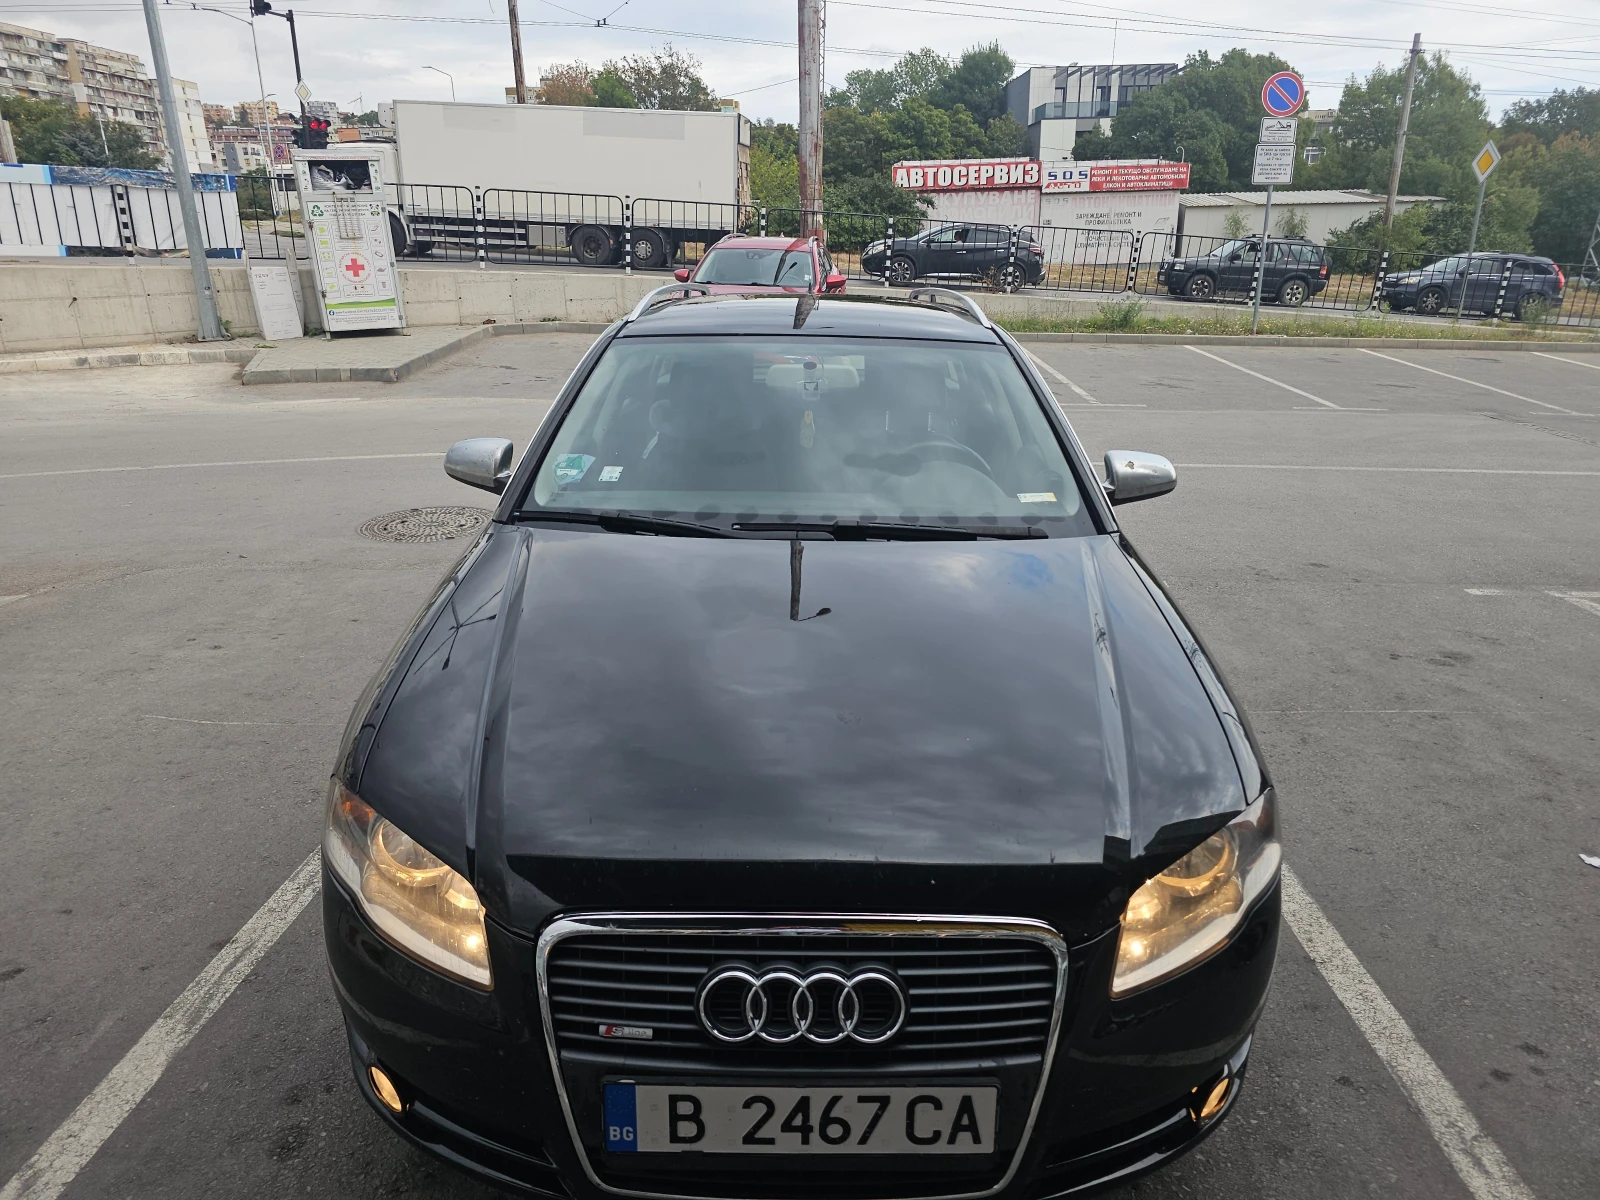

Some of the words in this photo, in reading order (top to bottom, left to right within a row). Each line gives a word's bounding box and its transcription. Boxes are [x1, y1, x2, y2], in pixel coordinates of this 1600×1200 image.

[895, 163, 1040, 188] АВТОСЕРВИЗ
[667, 1093, 706, 1144] B
[741, 1094, 891, 1145] 2467
[905, 1094, 983, 1145] CA
[609, 1125, 634, 1141] BG
